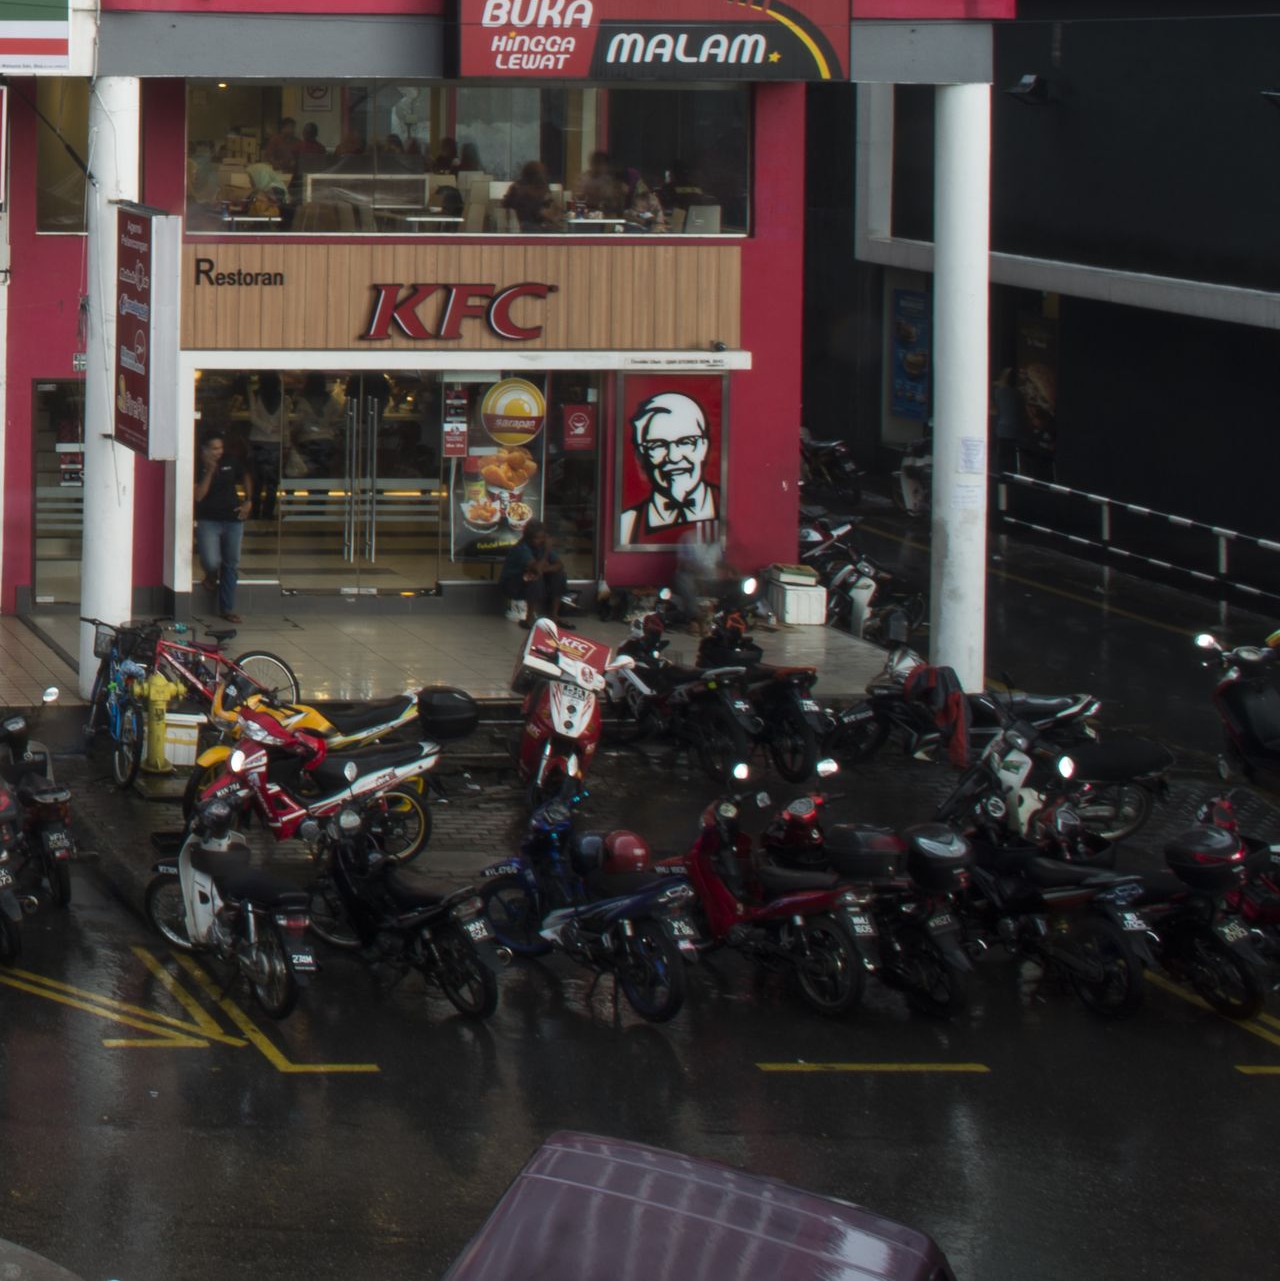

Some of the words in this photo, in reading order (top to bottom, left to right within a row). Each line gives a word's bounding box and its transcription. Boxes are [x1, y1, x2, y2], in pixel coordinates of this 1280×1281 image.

[495, 54, 571, 70] LEWAT
[606, 33, 767, 64] MALAM
[194, 258, 285, 287] Restoran
[360, 282, 552, 342] KFC
[560, 635, 589, 653] KFC
